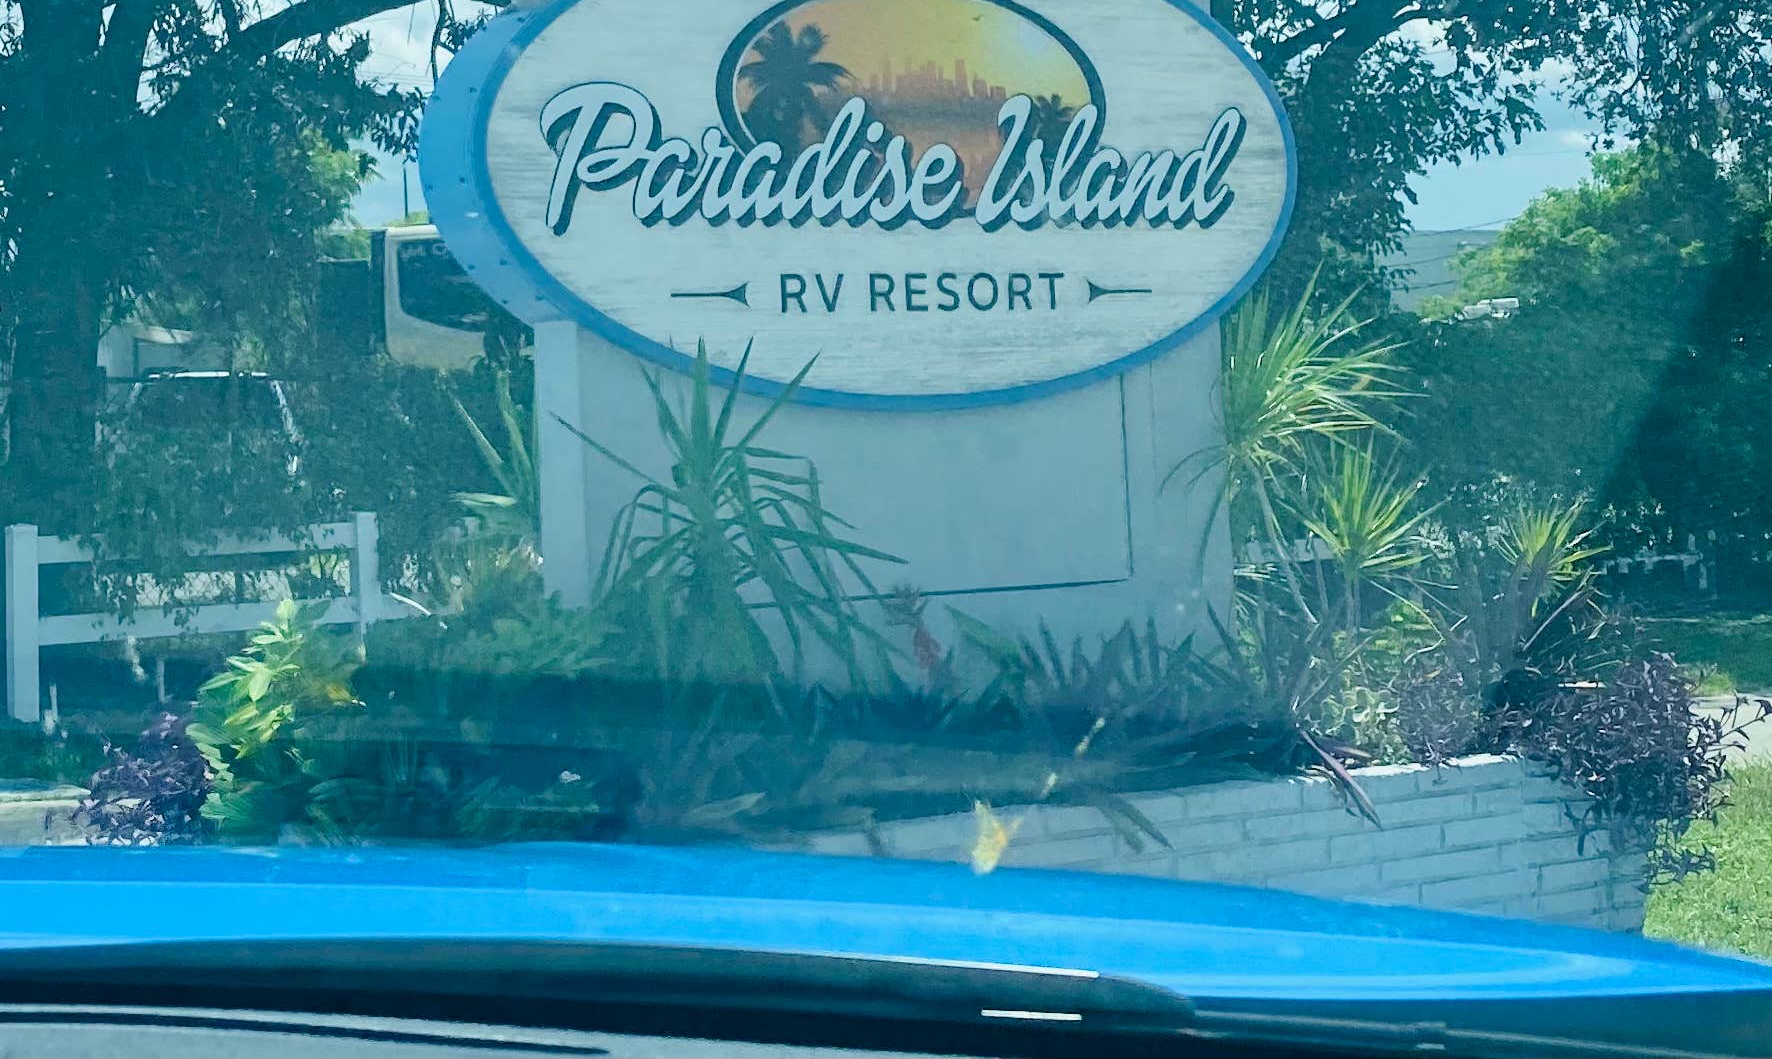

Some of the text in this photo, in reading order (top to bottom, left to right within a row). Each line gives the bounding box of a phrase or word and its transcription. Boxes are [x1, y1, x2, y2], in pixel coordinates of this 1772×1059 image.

[540, 81, 1246, 236] Paradise Island
[780, 272, 1066, 313] RV RESORT
